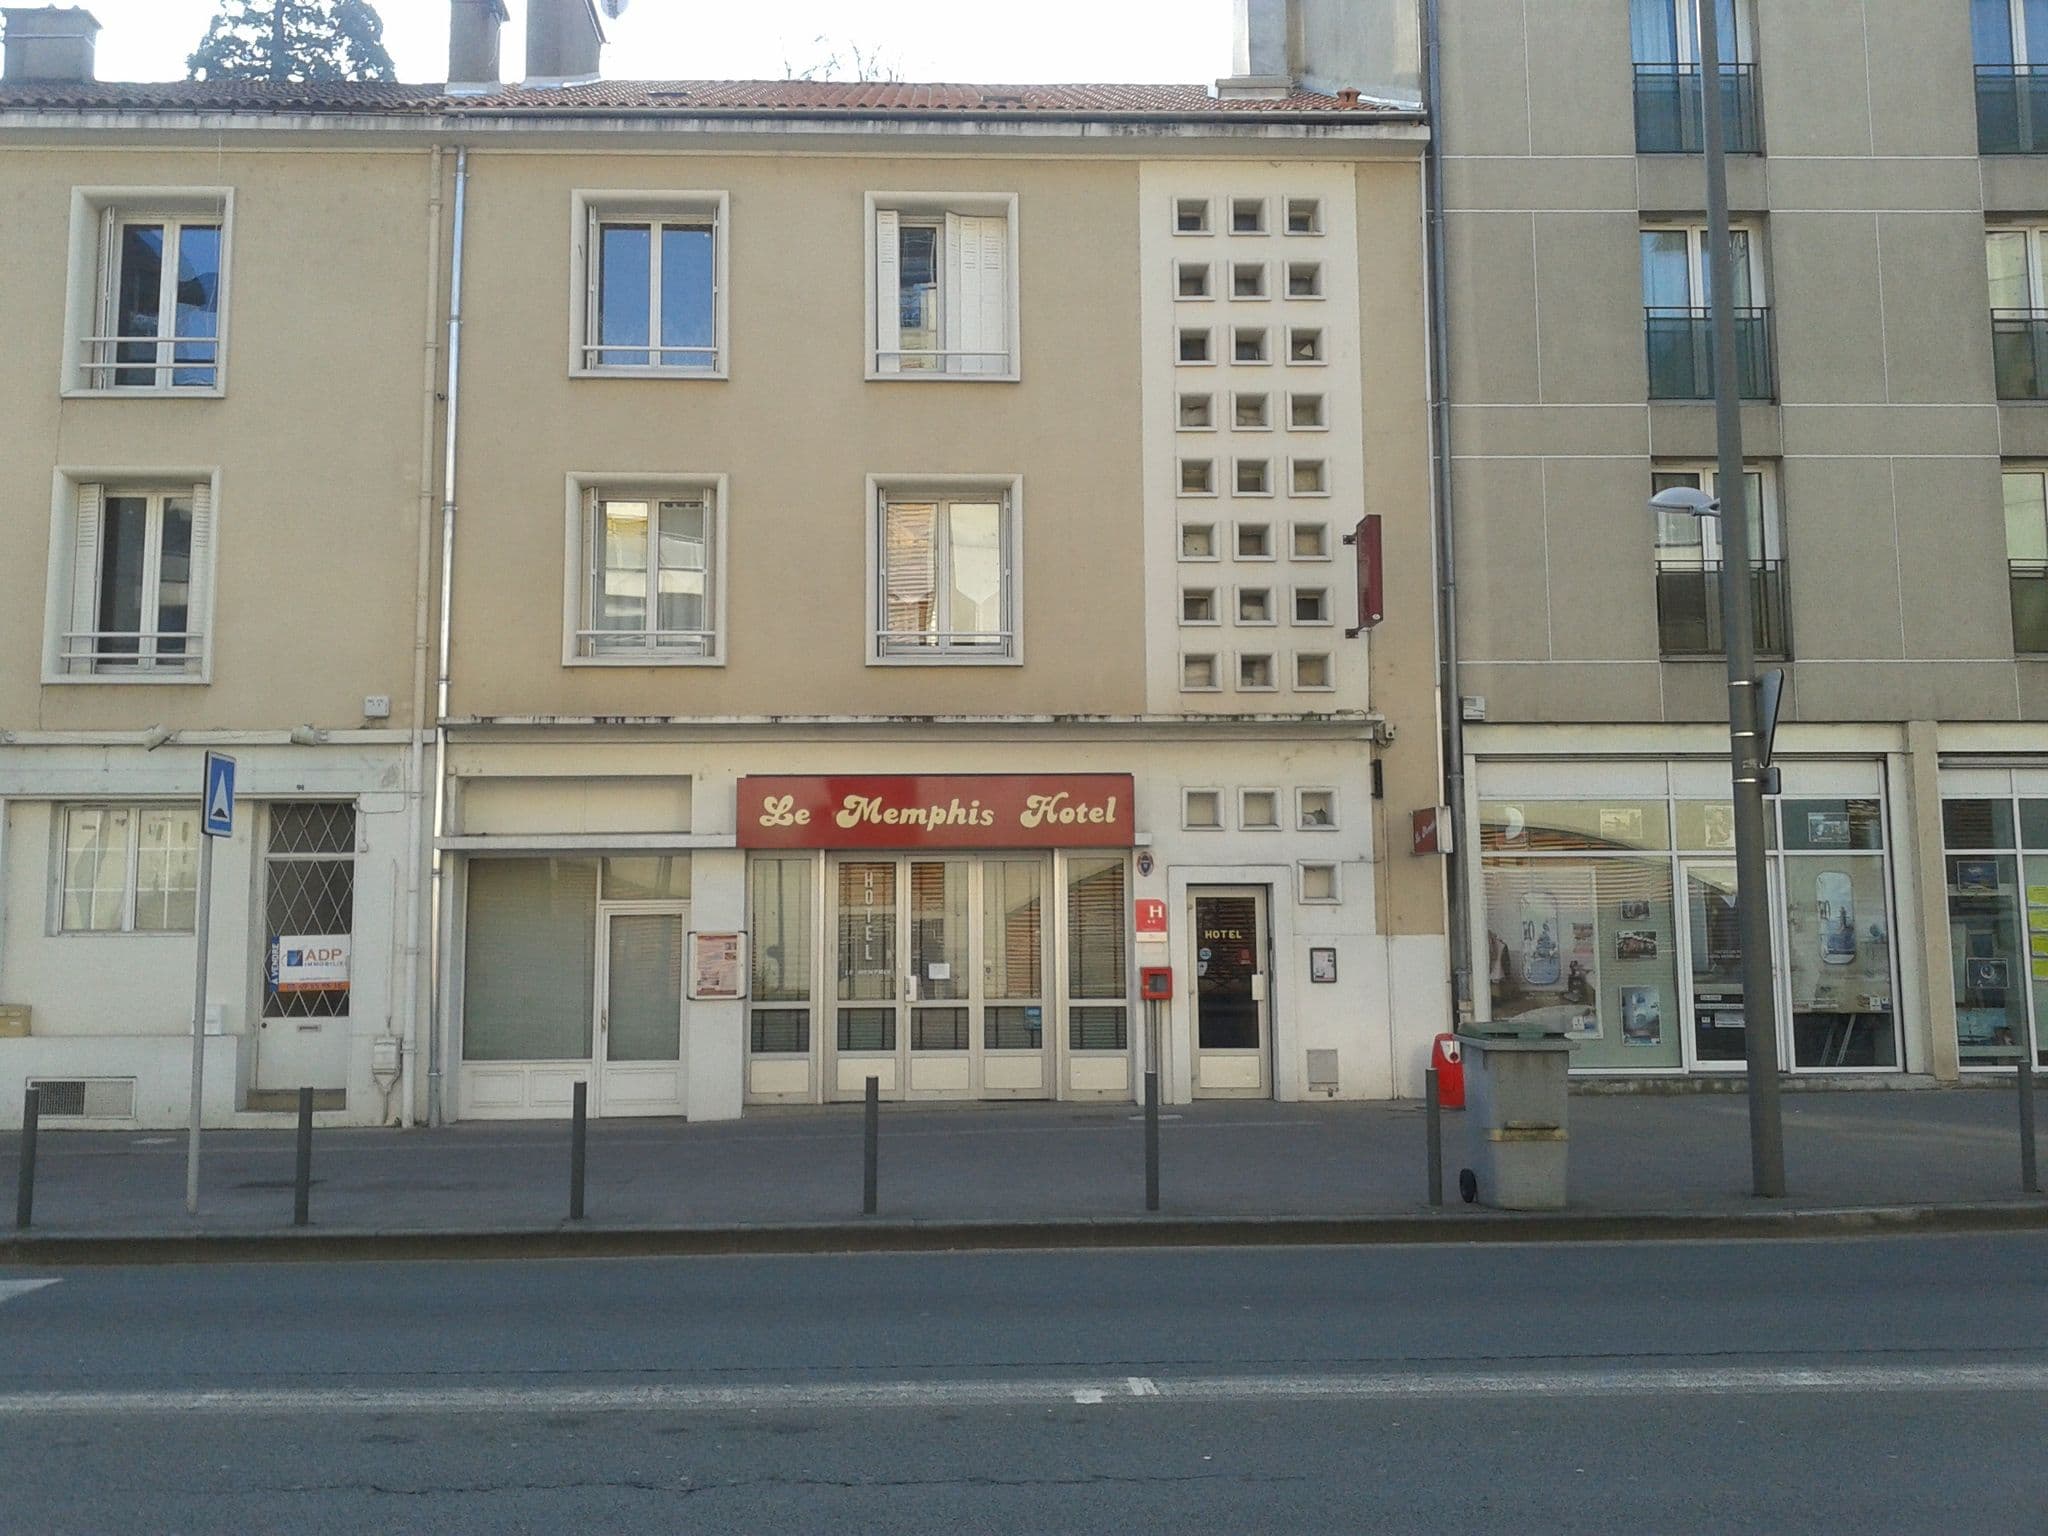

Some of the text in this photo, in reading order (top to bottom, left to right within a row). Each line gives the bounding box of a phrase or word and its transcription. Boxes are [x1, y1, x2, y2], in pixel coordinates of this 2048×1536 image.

[759, 792, 1116, 831] Le Memphis Hotel
[864, 872, 873, 960] HOTEL
[1150, 905, 1162, 918] H
[1205, 930, 1241, 939] HOTEL
[271, 943, 279, 976] VENDRE
[304, 948, 342, 961] ADP
